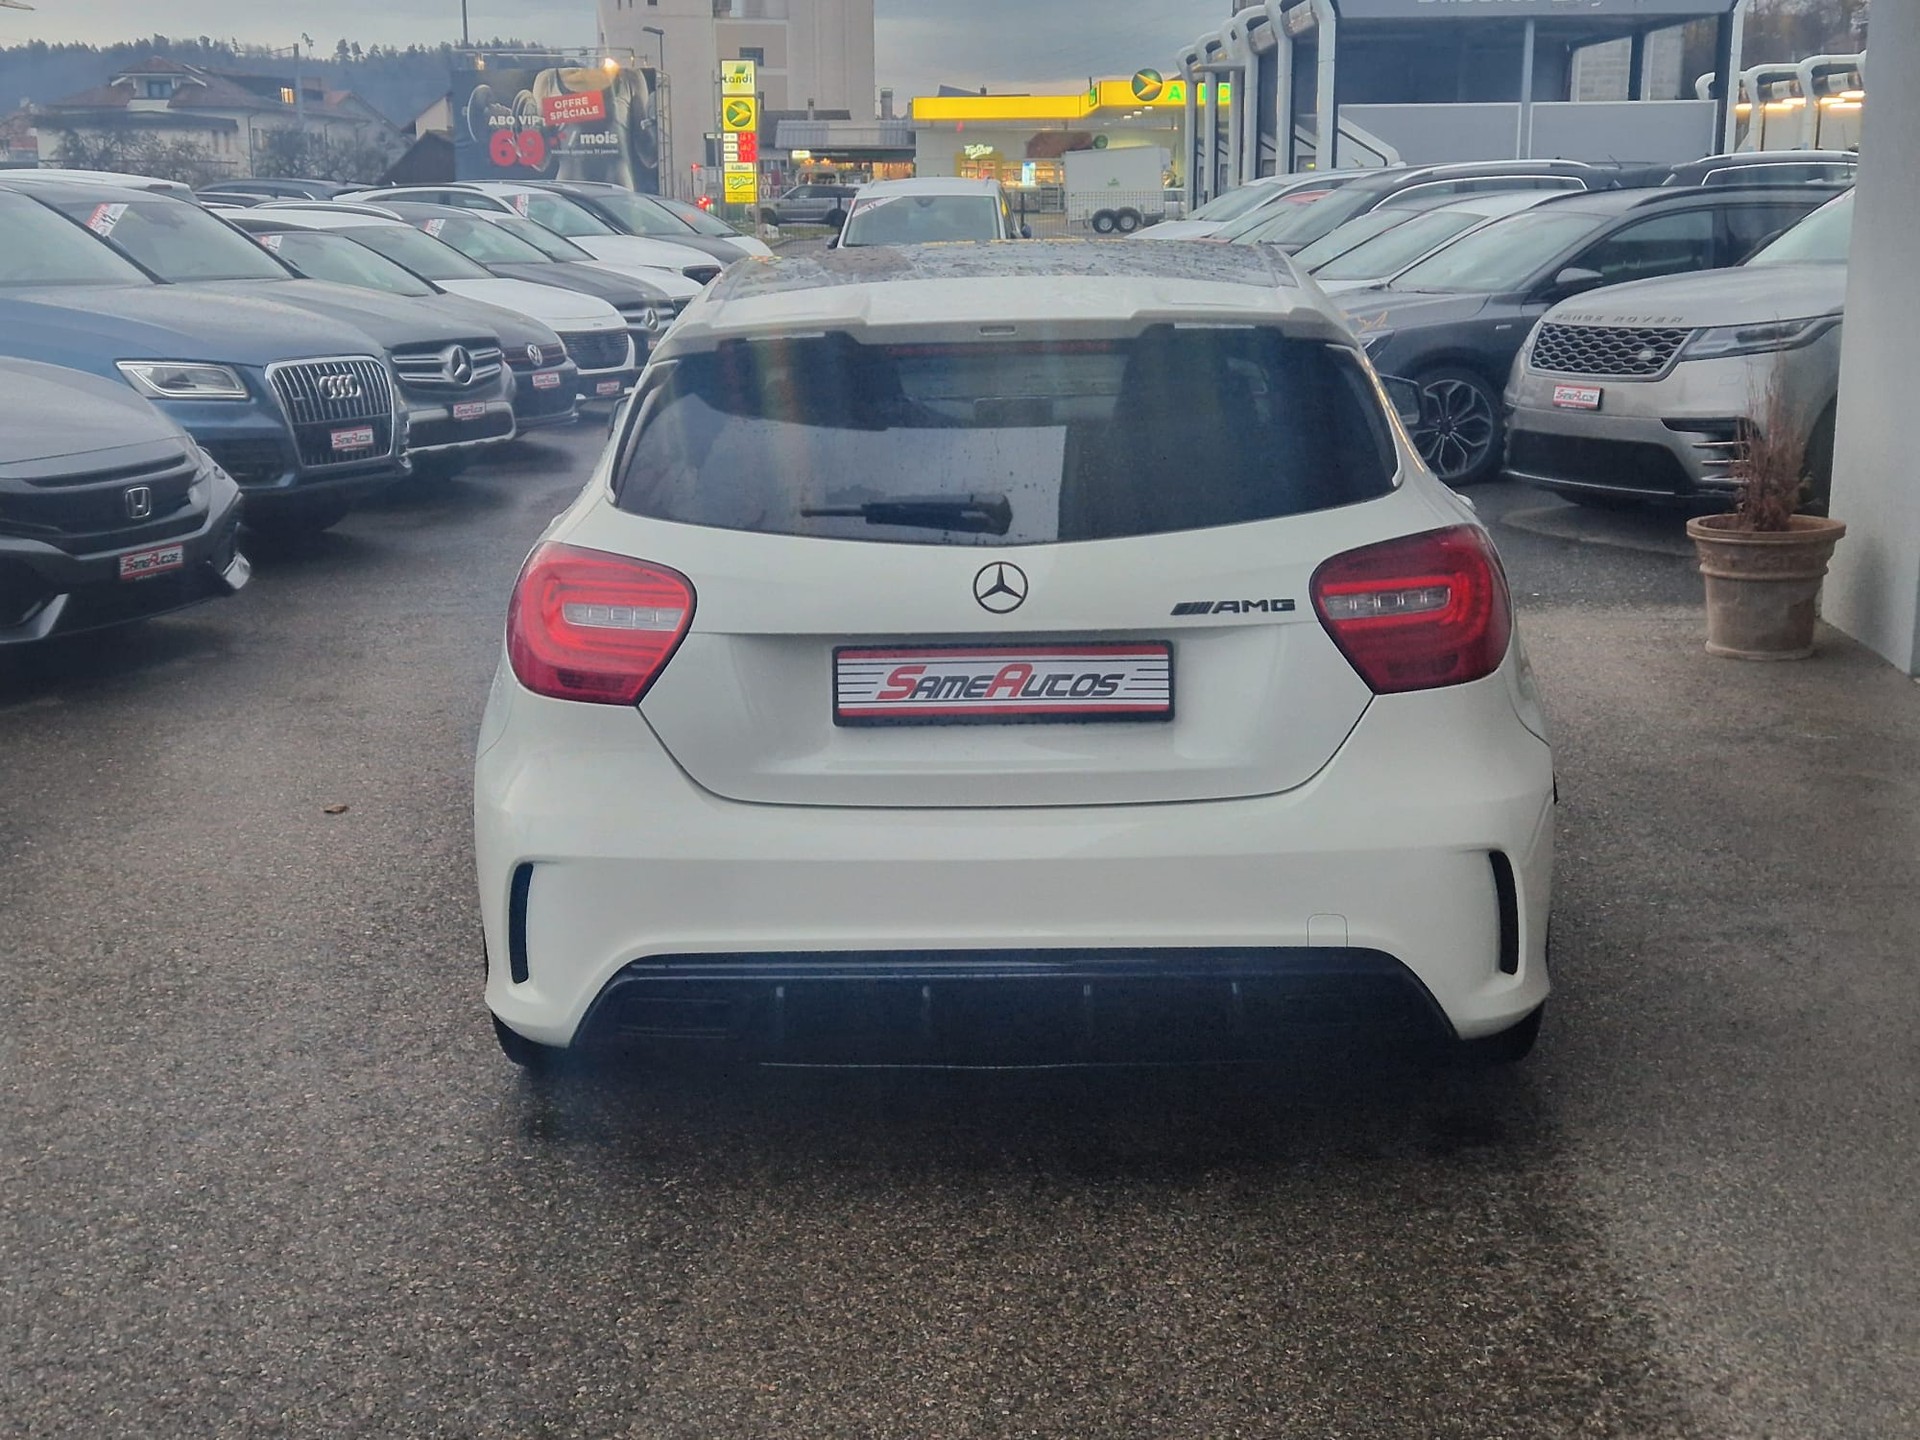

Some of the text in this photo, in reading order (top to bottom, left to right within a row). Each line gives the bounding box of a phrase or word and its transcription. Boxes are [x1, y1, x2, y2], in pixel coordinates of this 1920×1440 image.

[554, 96, 589, 110] OFFRE
[549, 105, 600, 121] SPÉCIALE
[488, 115, 516, 126] ABO
[580, 130, 619, 145] mois
[1613, 315, 1684, 324] ROVER
[1211, 598, 1296, 615] AMG
